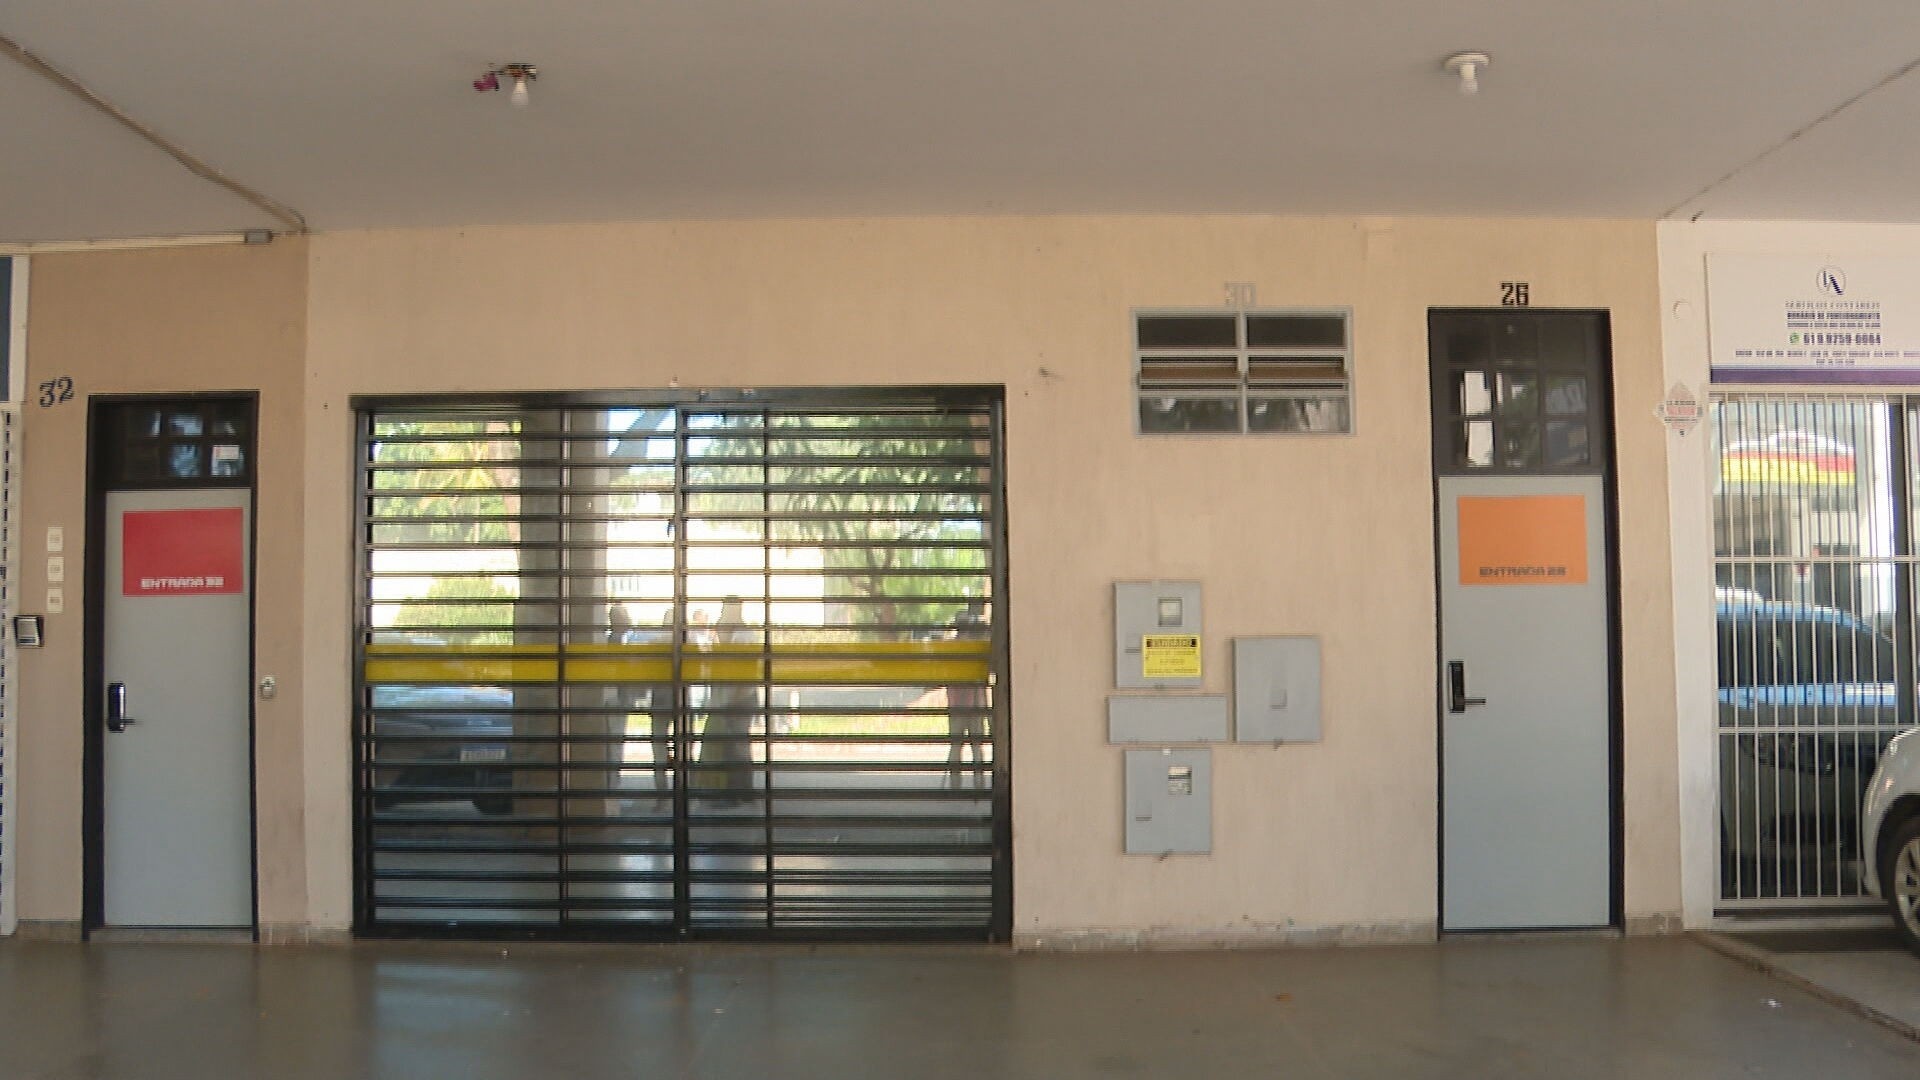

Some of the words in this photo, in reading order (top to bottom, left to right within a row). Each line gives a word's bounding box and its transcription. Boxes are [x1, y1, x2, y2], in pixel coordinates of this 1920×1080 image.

[1224, 281, 1256, 306] 30
[1501, 282, 1528, 305] 26
[39, 376, 74, 407] 32
[141, 576, 204, 589] ENTRADA
[1480, 566, 1545, 577] ENTRADA
